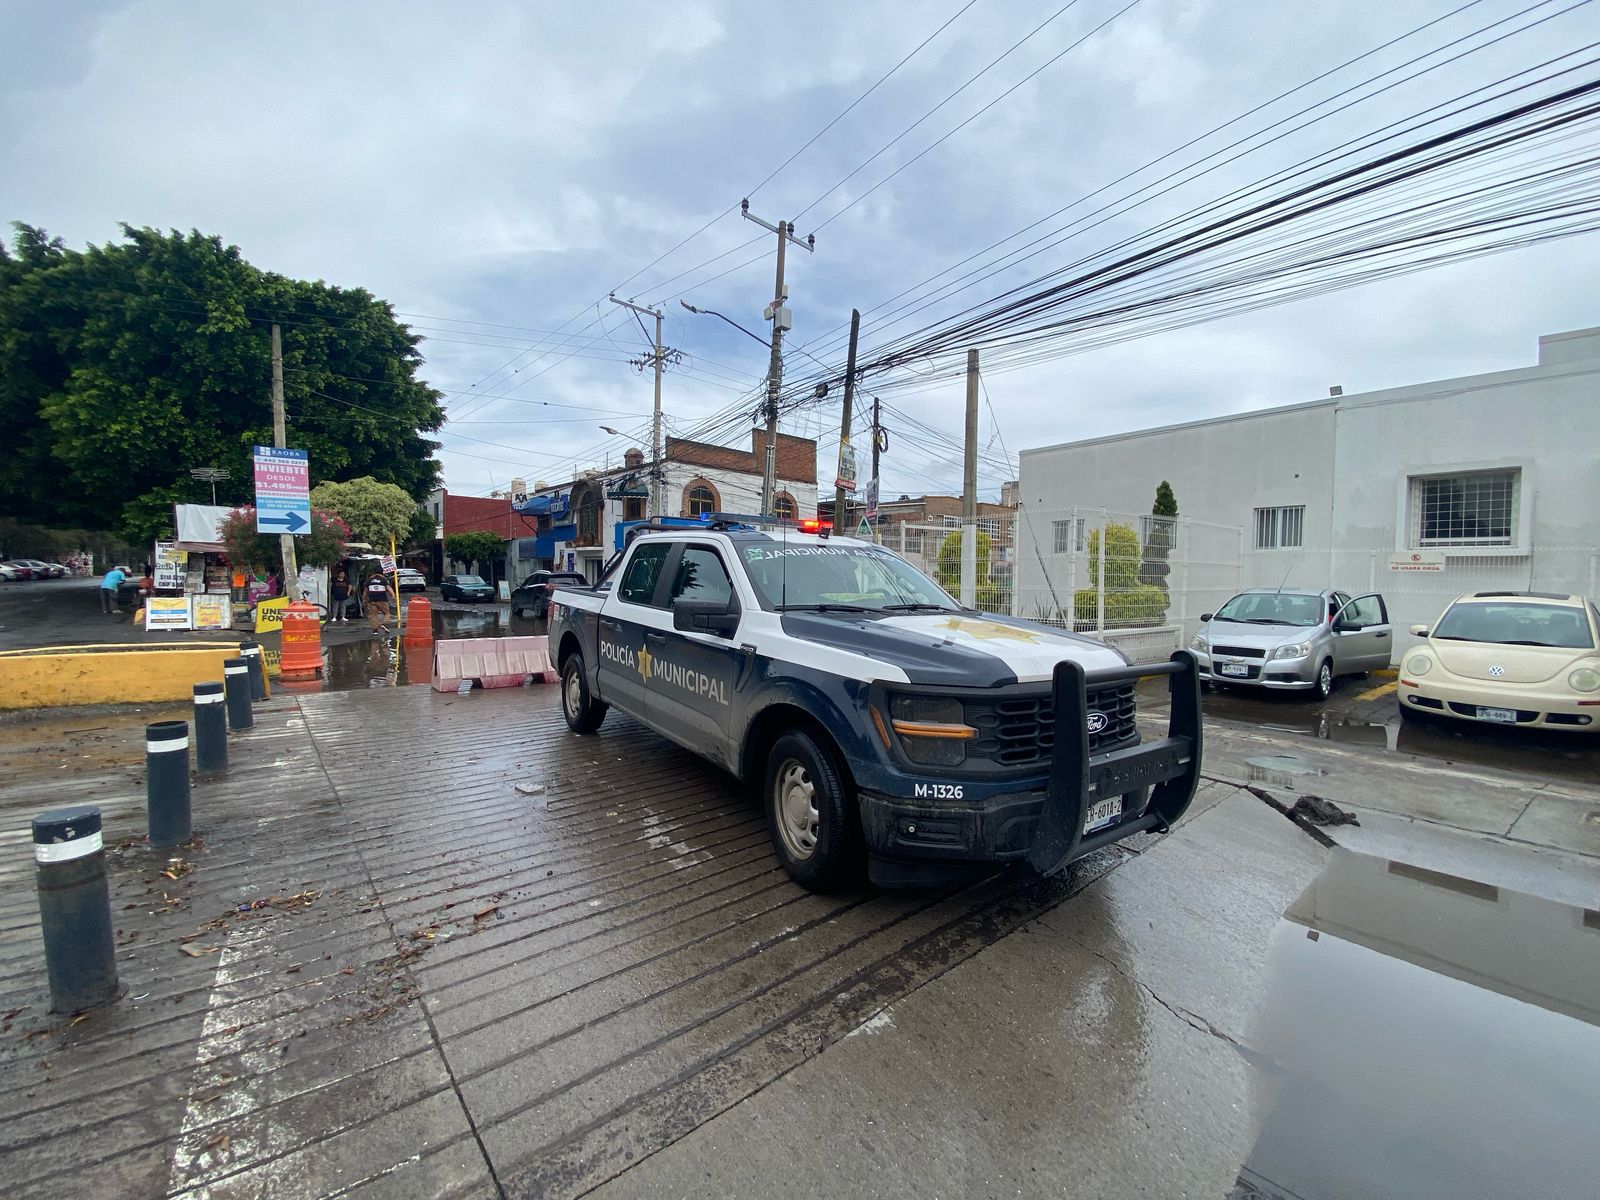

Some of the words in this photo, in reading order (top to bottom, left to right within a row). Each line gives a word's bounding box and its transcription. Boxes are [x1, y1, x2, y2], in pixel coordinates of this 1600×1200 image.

[271, 449, 300, 457] BAOBA
[255, 464, 306, 475] INVIERTE
[266, 474, 296, 482] DESDE
[600, 640, 636, 669] POLICÍA
[654, 657, 729, 706] MUNICIPAL
[1087, 716, 1103, 730] Ford
[914, 783, 964, 799] M-1326
